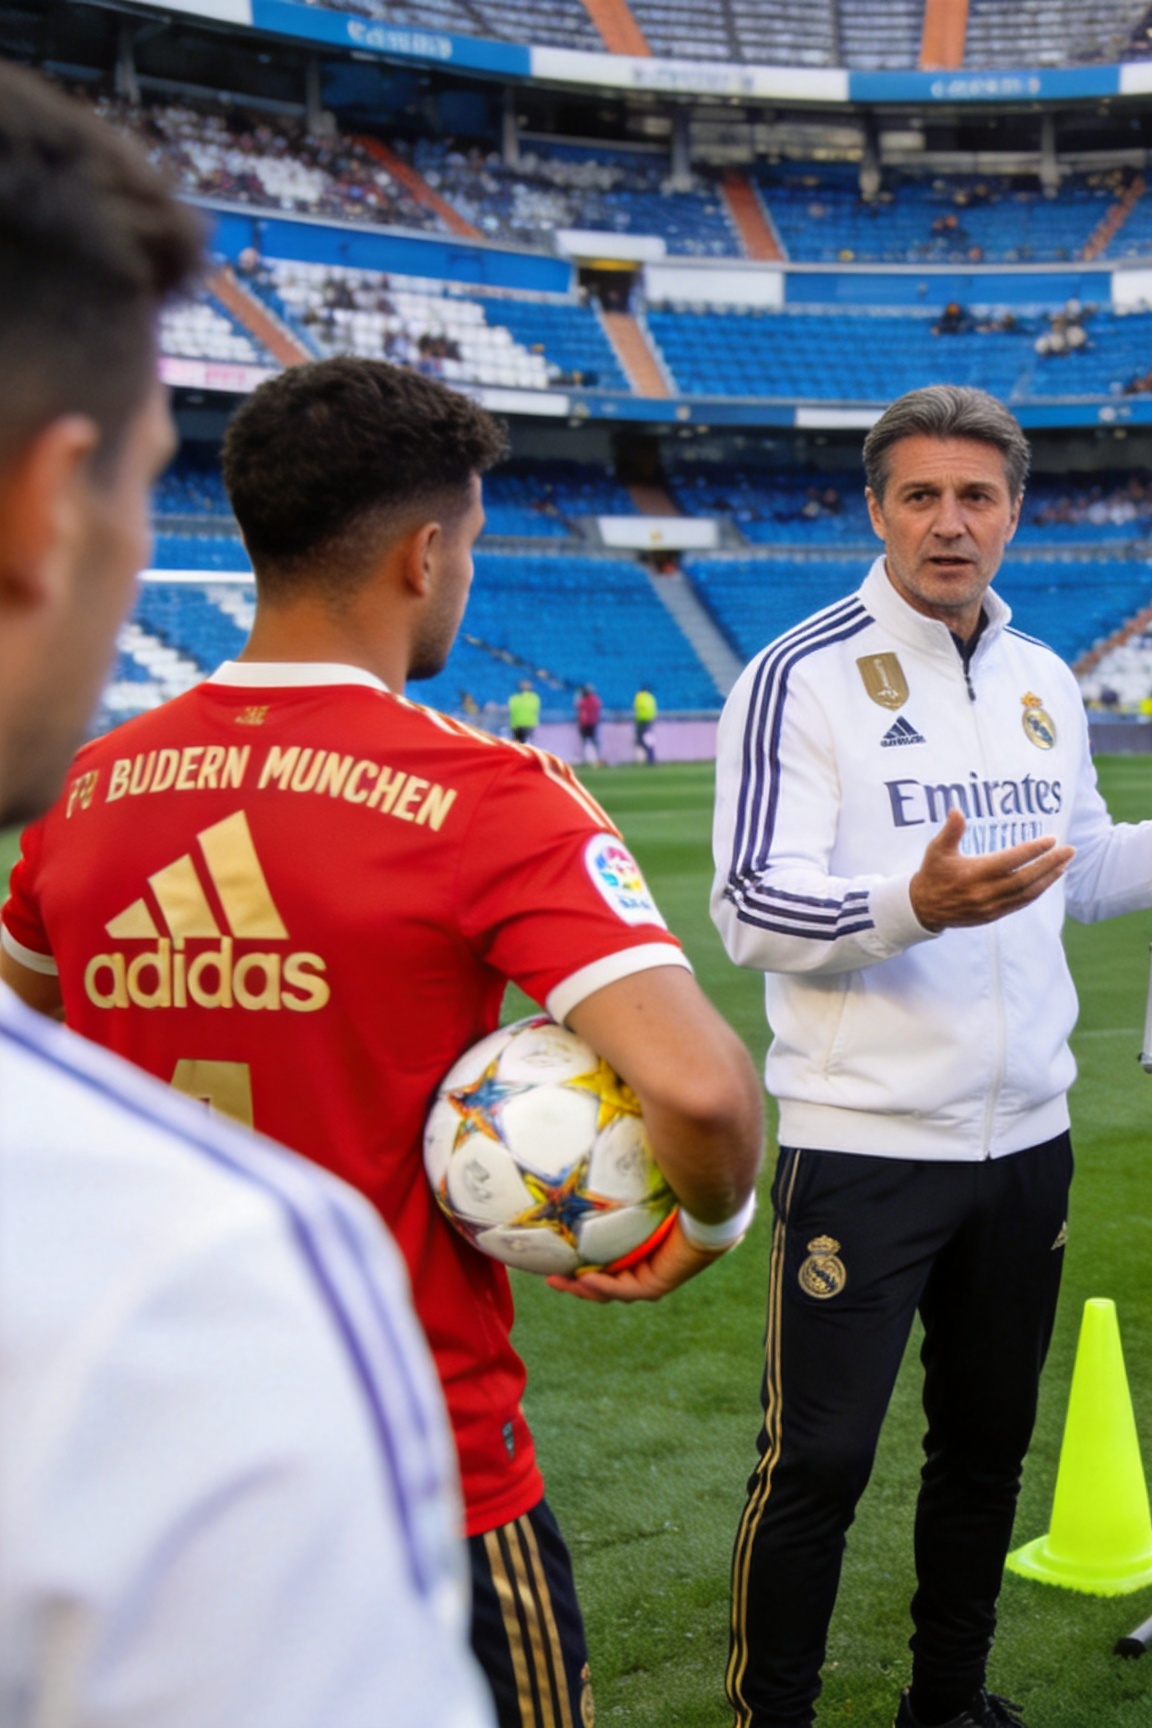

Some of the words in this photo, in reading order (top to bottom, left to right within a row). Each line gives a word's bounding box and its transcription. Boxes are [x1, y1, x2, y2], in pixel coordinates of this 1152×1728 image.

[105, 745, 251, 803] BUDERN
[258, 745, 457, 832] MUNCHEN
[884, 771, 1062, 828] Emirates
[84, 936, 331, 1012] adidas
